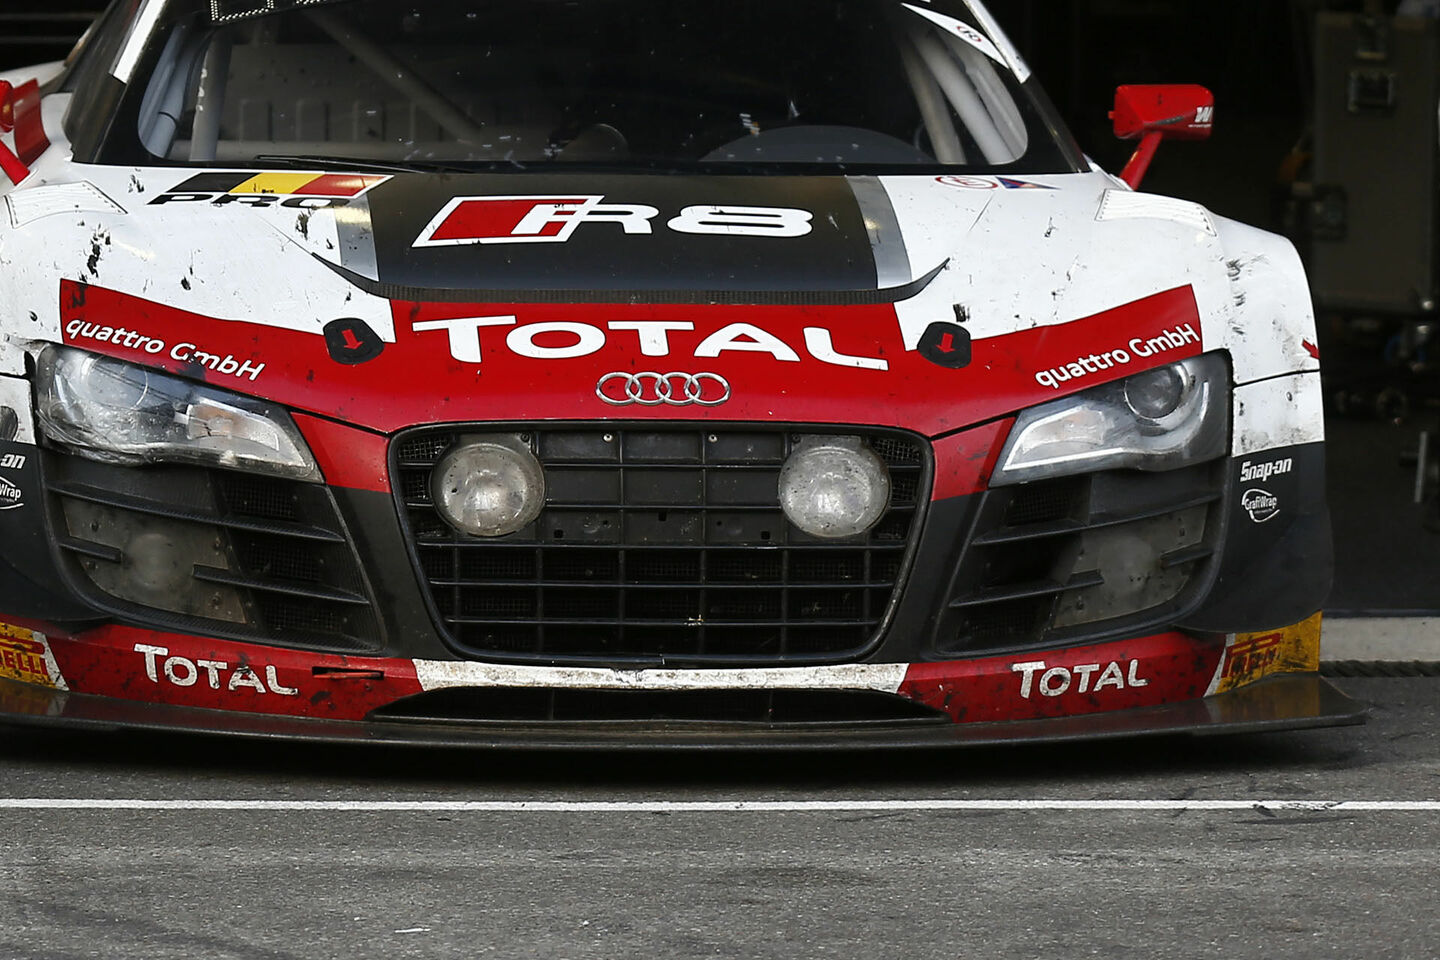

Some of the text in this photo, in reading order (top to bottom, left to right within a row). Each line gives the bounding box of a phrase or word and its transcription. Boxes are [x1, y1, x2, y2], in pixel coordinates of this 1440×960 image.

[146, 191, 354, 209] PRO
[507, 200, 815, 238] R8
[64, 318, 266, 382] quattro GmbH
[412, 314, 890, 371] TOTAL
[1034, 322, 1201, 390] quattro GmbH
[133, 642, 299, 696] TOTAL
[1011, 658, 1150, 700] TOTAL
